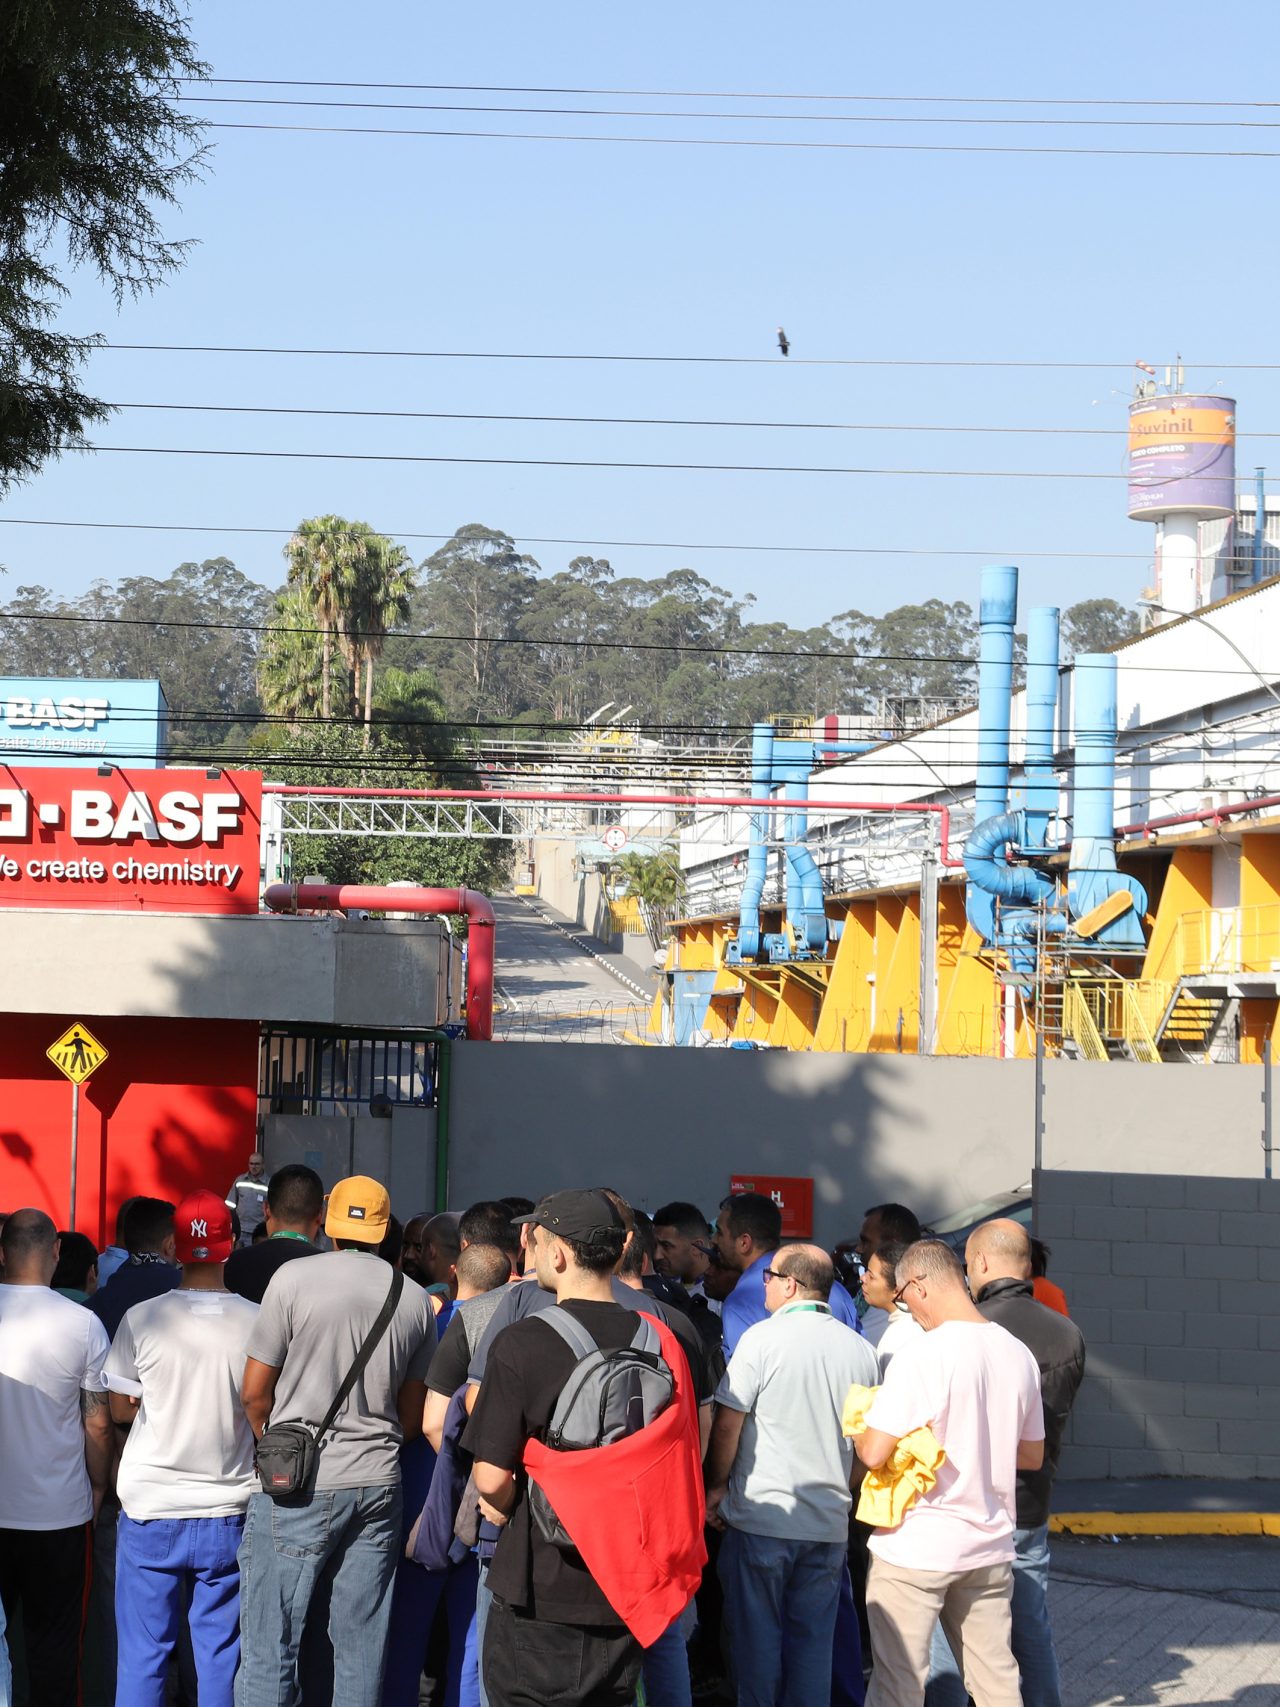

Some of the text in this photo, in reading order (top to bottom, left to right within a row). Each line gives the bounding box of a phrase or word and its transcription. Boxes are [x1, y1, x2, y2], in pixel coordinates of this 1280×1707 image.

[1137, 418, 1193, 437] Suvinil
[7, 697, 108, 729] BASF
[34, 735, 107, 753] chemistry
[71, 789, 240, 842] BASF
[26, 857, 104, 879] create
[112, 857, 240, 887] chemistry
[771, 1190, 781, 1202] H
[190, 1218, 207, 1238] NY
